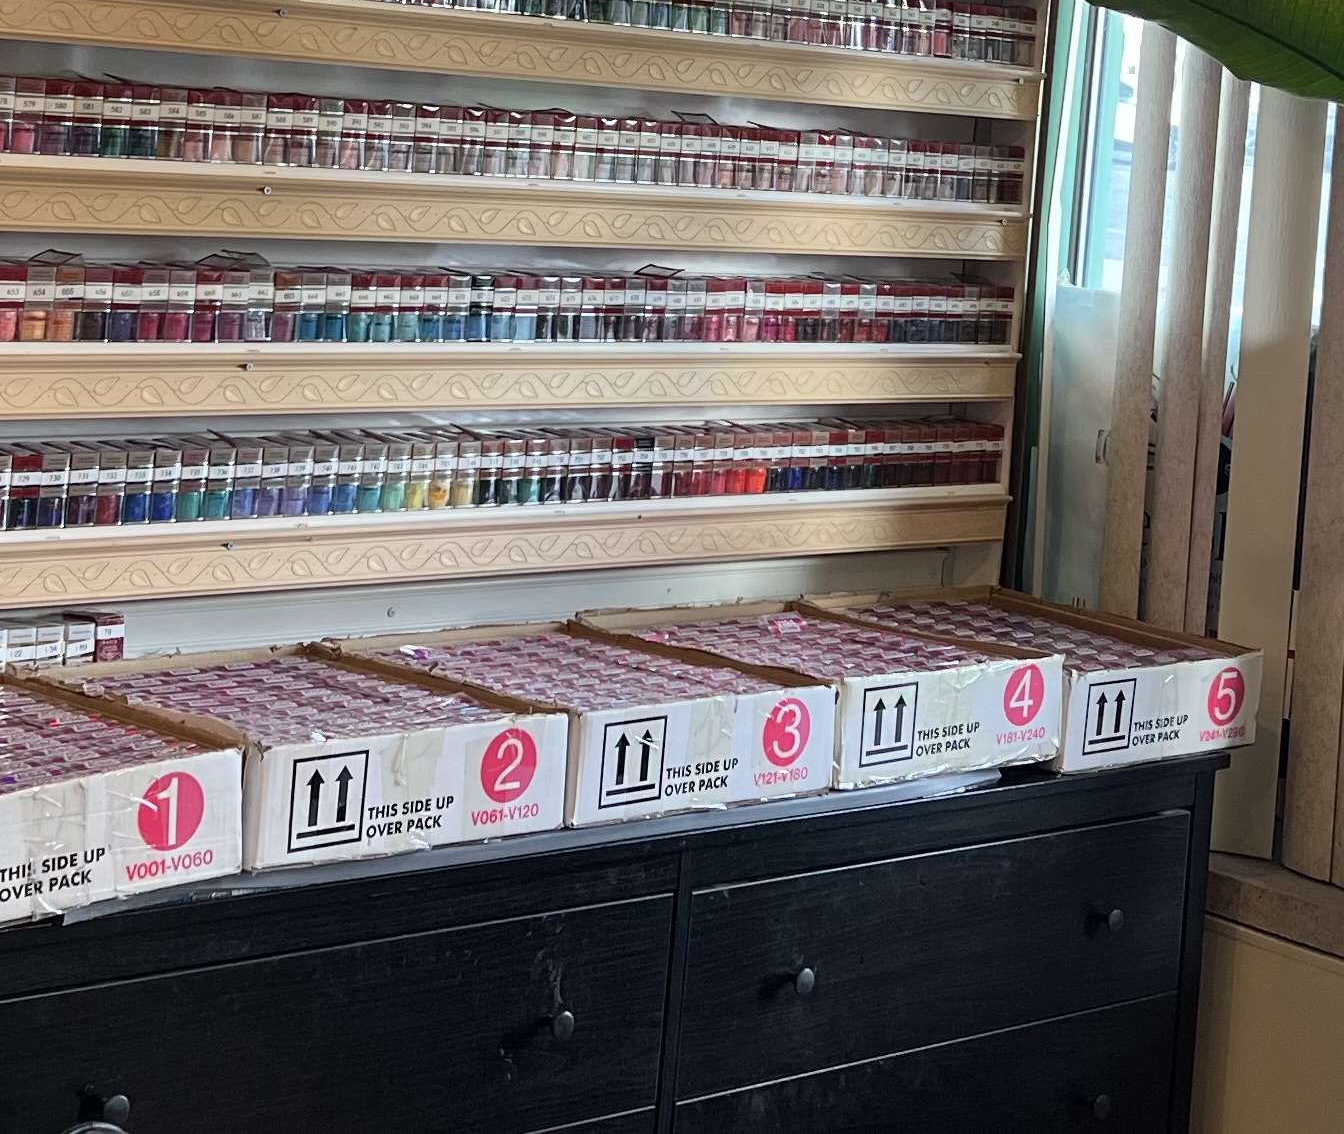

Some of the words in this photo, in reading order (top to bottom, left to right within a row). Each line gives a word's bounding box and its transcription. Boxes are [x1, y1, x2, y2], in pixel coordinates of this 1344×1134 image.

[1009, 669, 1034, 717] 4
[1214, 673, 1239, 721] 5
[775, 704, 802, 758] 3
[917, 727, 941, 741] THIS
[943, 724, 964, 739] SIDE
[966, 721, 980, 734] UP
[1133, 721, 1154, 733] THIS
[1155, 718, 1175, 731] SIDE
[1177, 714, 1189, 727] UP
[916, 742, 943, 757] OVER
[945, 738, 971, 751] PACK
[996, 728, 1046, 746] V181-V240
[1132, 734, 1155, 747] OVER
[1157, 729, 1181, 742] PACK
[492, 738, 524, 792] 2
[666, 763, 691, 780] THIS
[694, 761, 718, 776] SIDE
[721, 757, 738, 773] UP
[664, 780, 694, 795] OVER
[698, 775, 729, 791] PACK
[162, 778, 179, 846] 1
[368, 804, 402, 821] THIS
[405, 800, 431, 818] SIDE
[435, 796, 454, 812] UP
[471, 803, 539, 826] V061-V120
[366, 820, 401, 839] OVER
[407, 815, 442, 832] PACK
[0, 864, 36, 883] THIS
[41, 853, 81, 877] SIDE
[83, 848, 105, 868] UP
[126, 850, 213, 881] V001-V060
[41, 871, 92, 894] PACK
